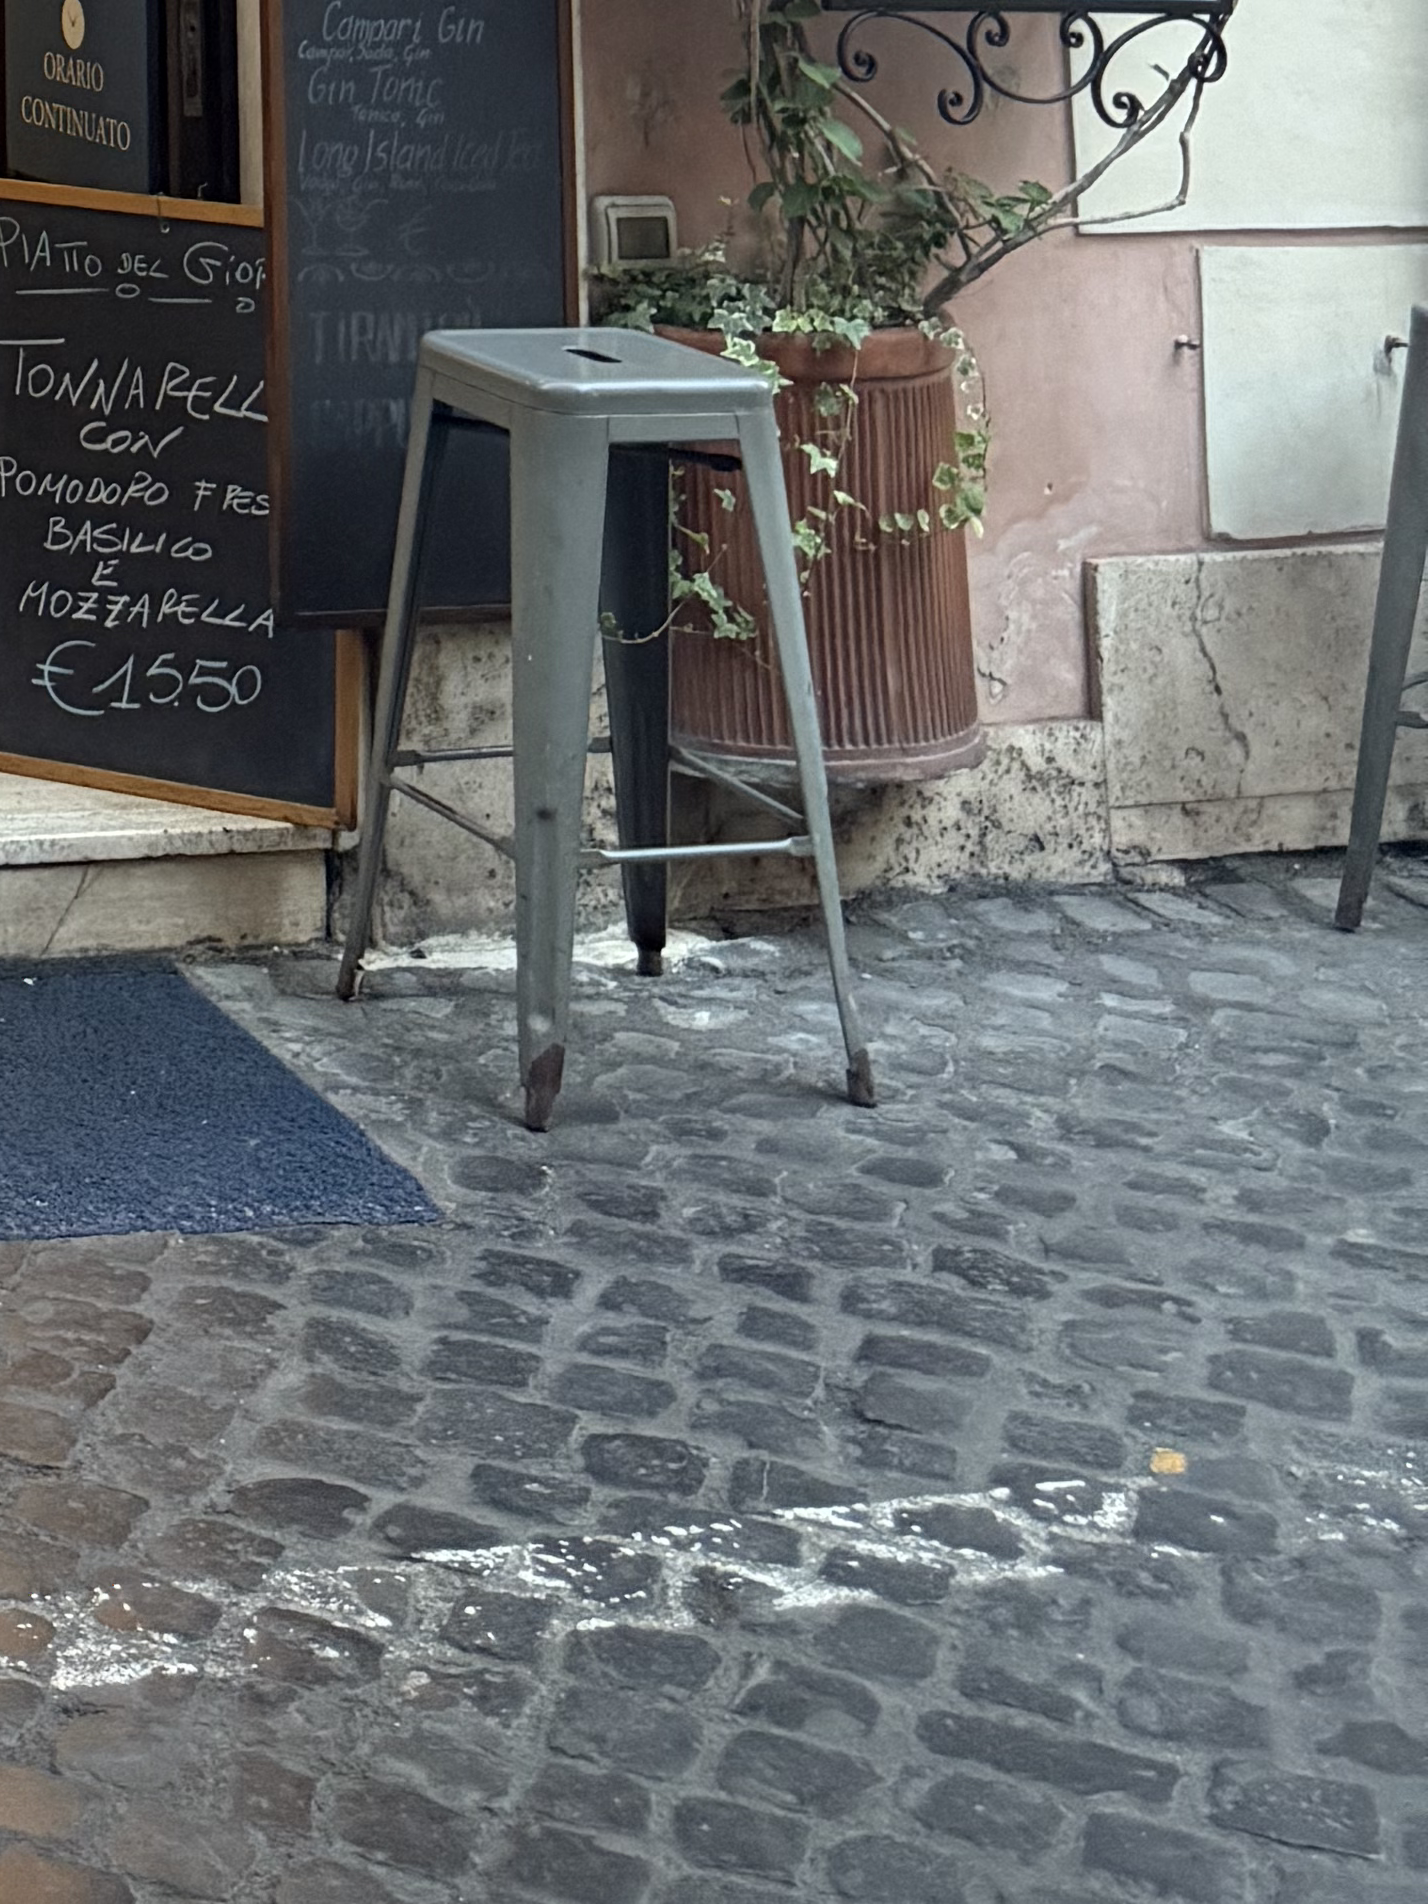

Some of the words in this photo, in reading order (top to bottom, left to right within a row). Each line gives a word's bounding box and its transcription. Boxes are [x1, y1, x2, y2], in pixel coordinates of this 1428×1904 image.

[322, 0, 423, 46] Campari
[438, 6, 485, 44] Gin
[43, 49, 105, 92] ORARIO
[307, 68, 356, 106] Gin
[20, 95, 132, 152] CONTINUATO
[115, 250, 169, 280] DEL
[79, 421, 184, 459] CON
[192, 478, 270, 518] FRES
[43, 514, 213, 563] BASILICO
[90, 559, 119, 588] E
[18, 581, 276, 639] MOZZARELLA
